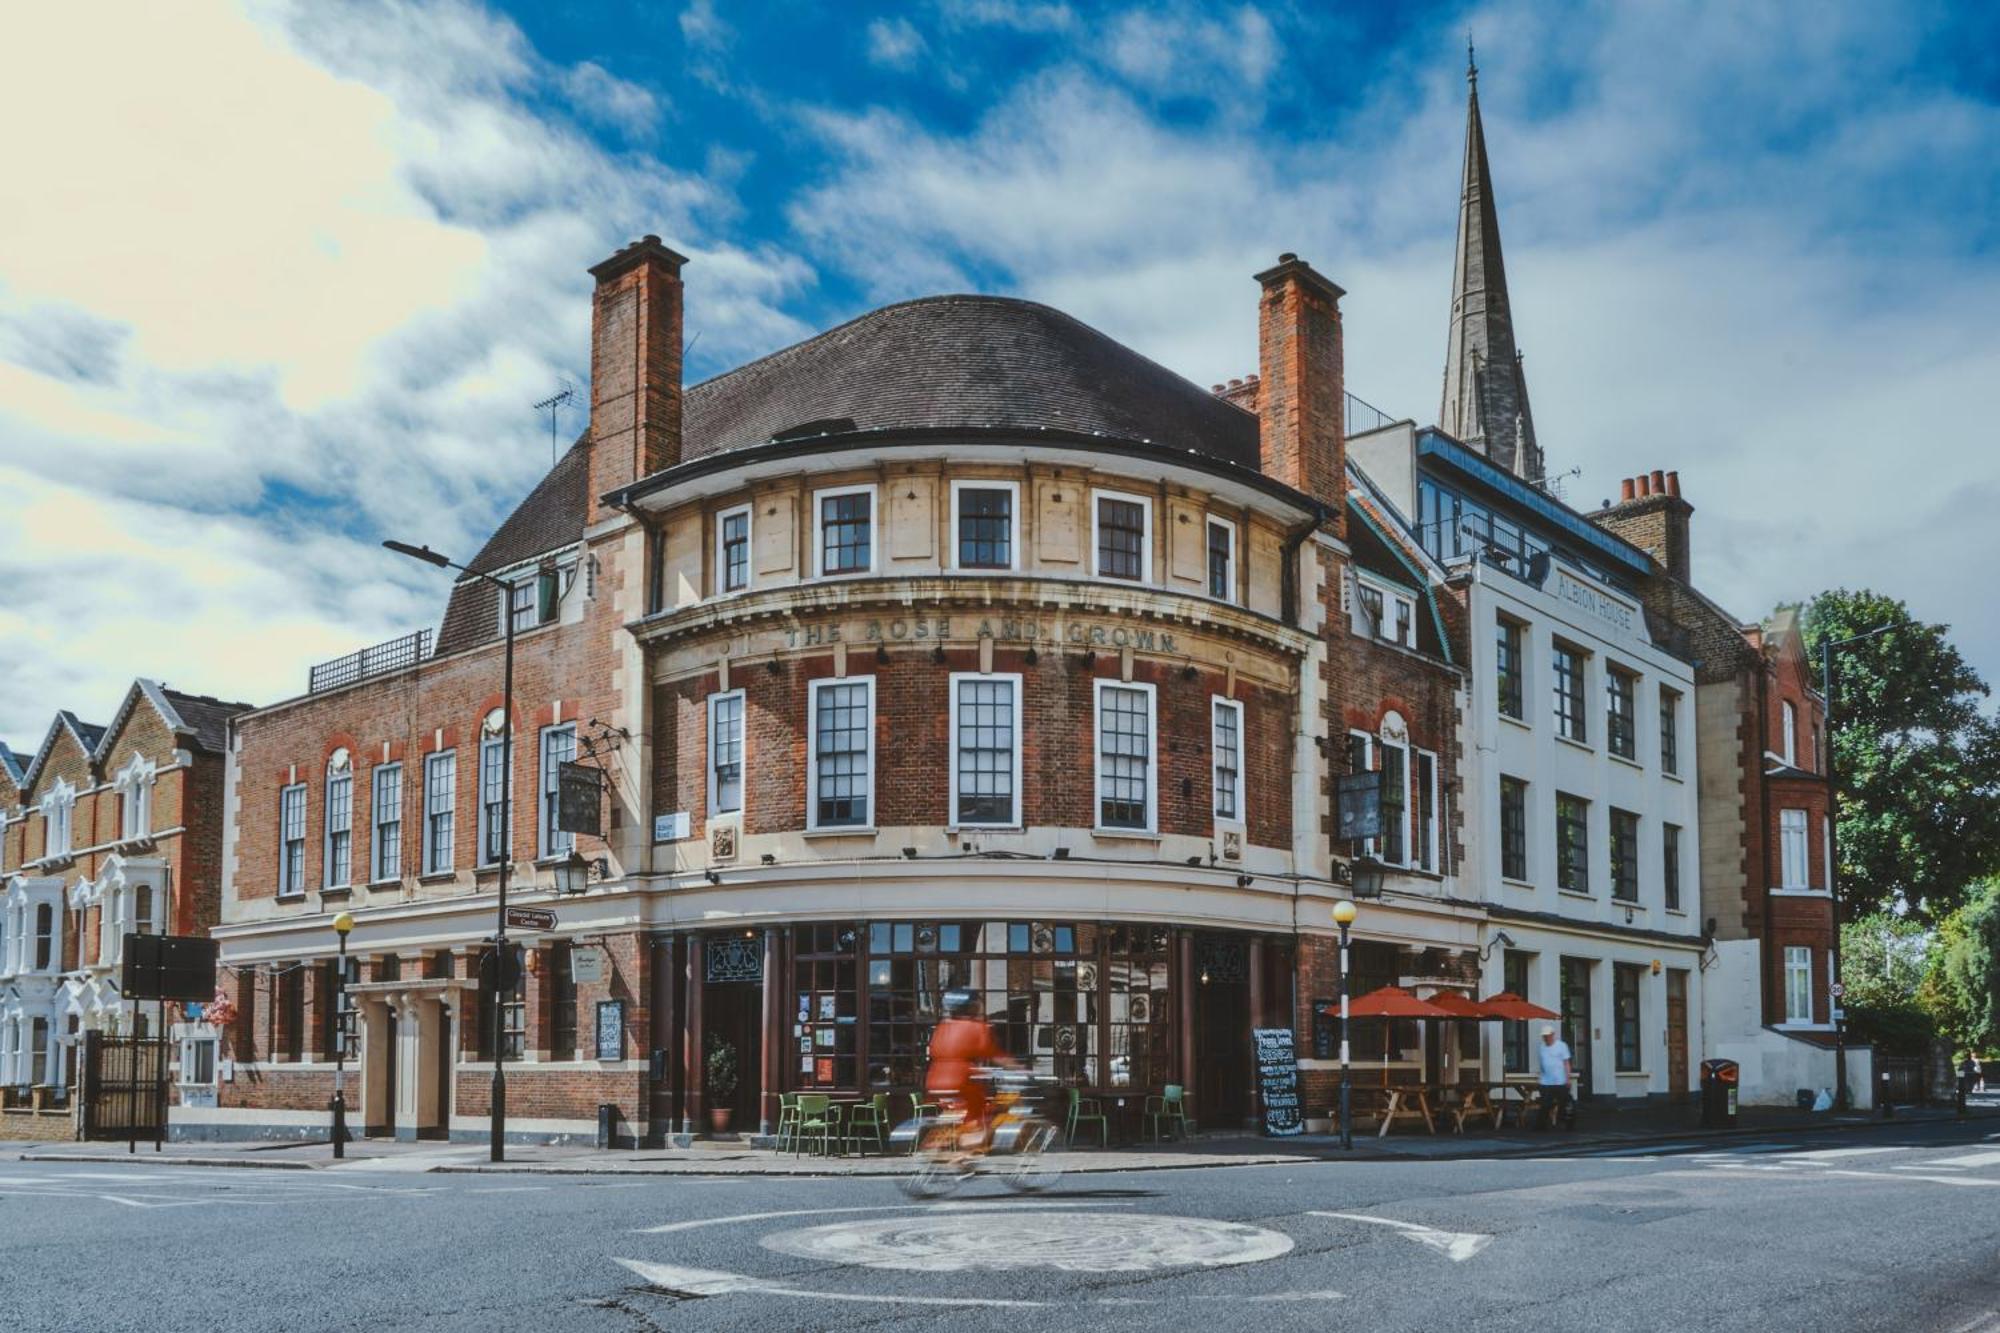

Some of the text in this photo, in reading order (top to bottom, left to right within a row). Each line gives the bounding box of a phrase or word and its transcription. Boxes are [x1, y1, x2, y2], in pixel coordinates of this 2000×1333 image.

[1558, 575, 1632, 630] ALBION HOUSE
[785, 617, 1178, 652] THE ROSE AND CROWN
